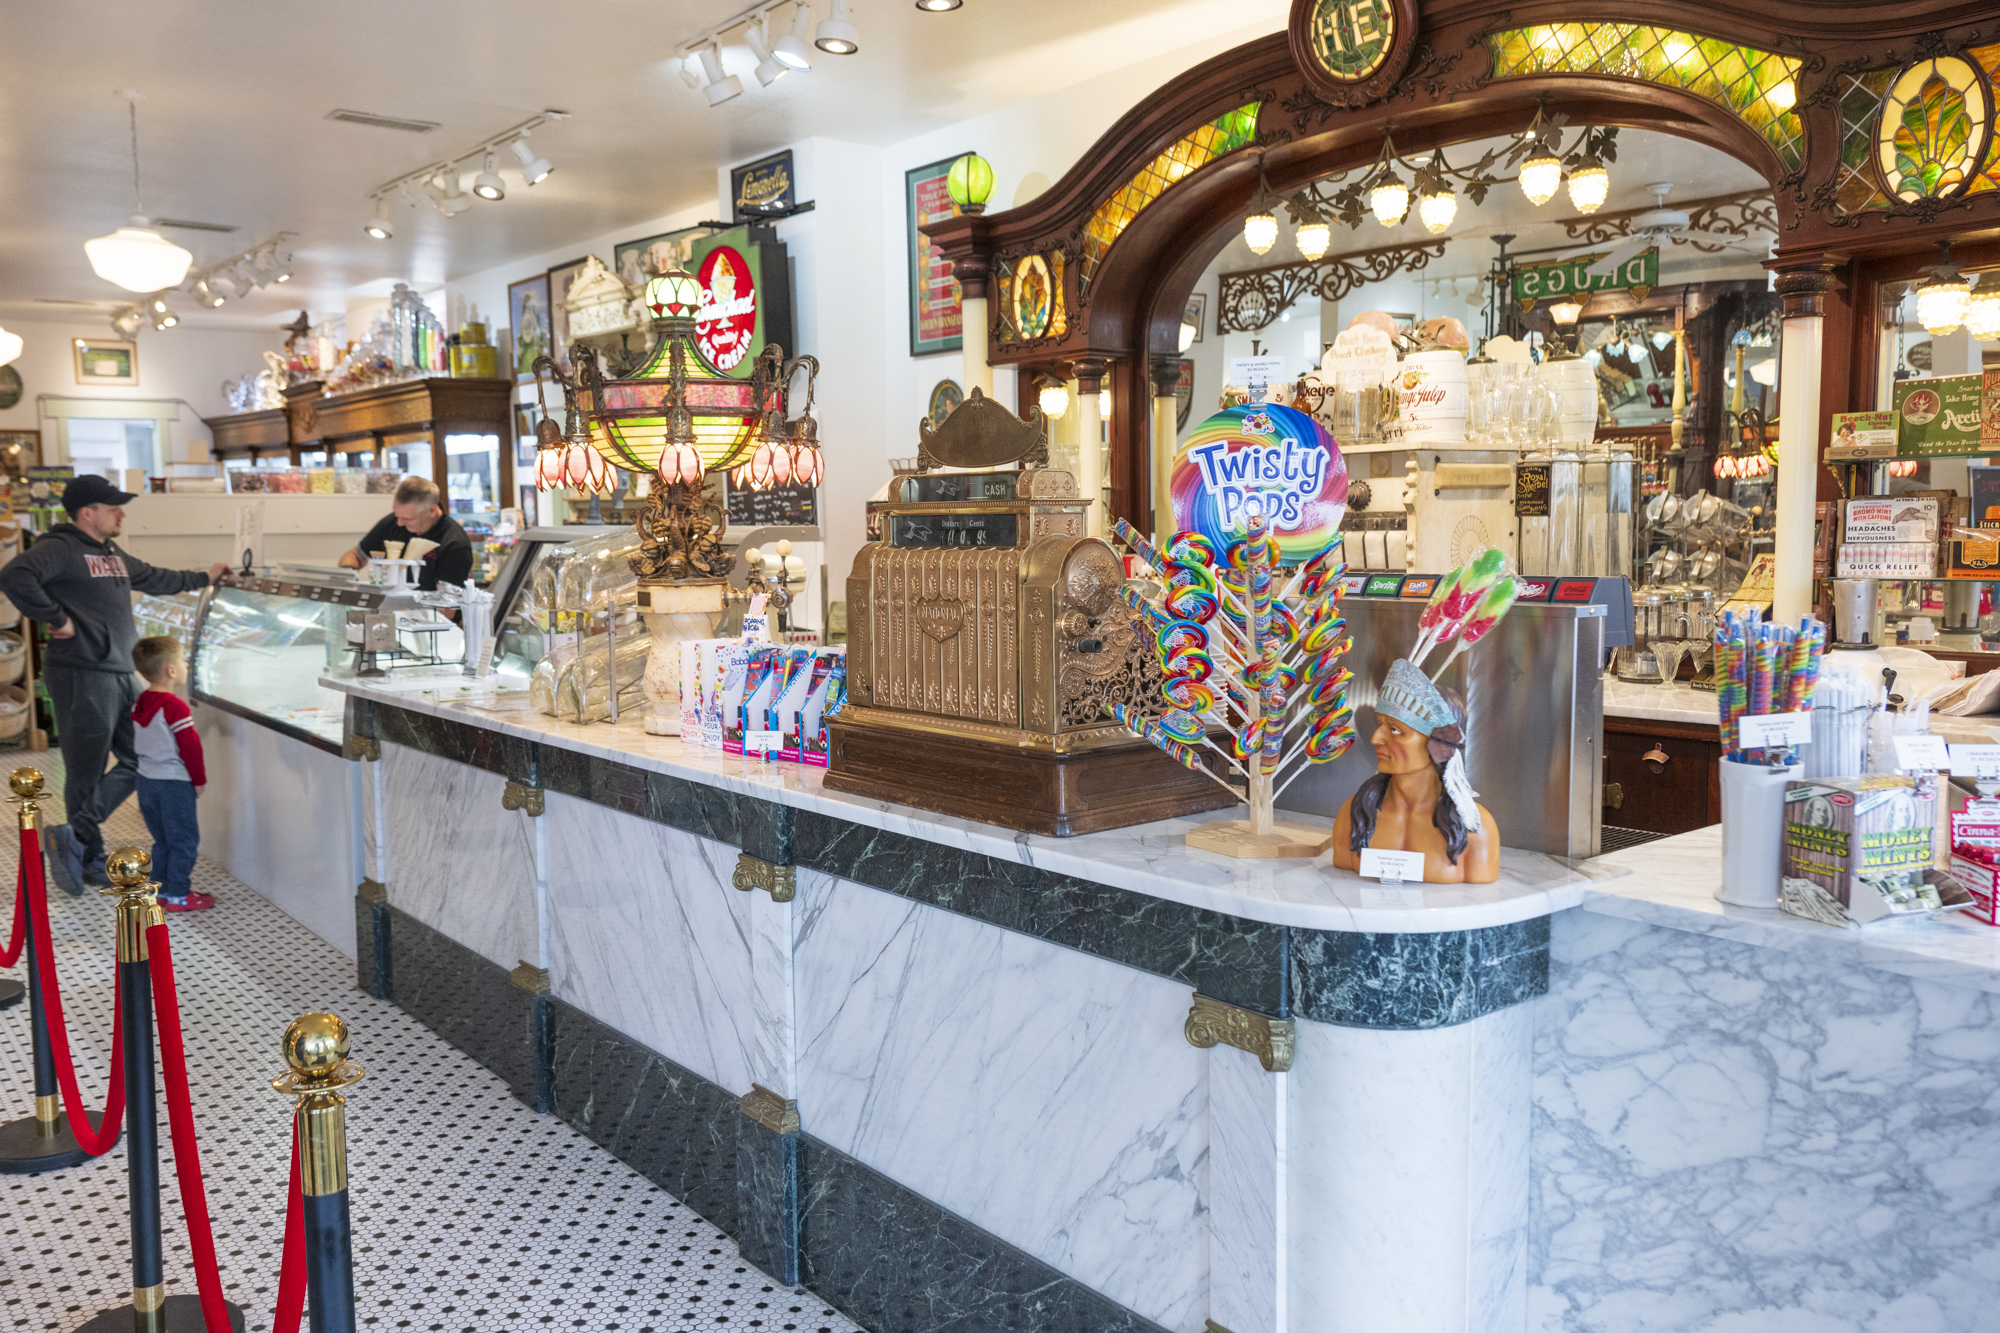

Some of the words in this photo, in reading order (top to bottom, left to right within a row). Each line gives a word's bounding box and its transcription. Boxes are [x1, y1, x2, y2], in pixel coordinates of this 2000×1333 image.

[717, 328, 753, 370] CREAM
[1945, 395, 1961, 403] Take
[1961, 394, 1979, 402] Home
[1840, 413, 1893, 422] Beech-Nut
[1941, 409, 1981, 430] Arcti
[1193, 441, 1325, 494] Twisty
[1520, 470, 1546, 483] Royal
[985, 485, 1006, 495] CASH
[1219, 485, 1300, 532] Pops
[1853, 508, 1892, 516] BROMO-MINT
[1370, 580, 1397, 590] Sprite
[1408, 581, 1428, 589] FANTA
[922, 606, 960, 620] NATIONAL
[745, 618, 764, 626] POPPING
[747, 624, 760, 632] BOBA
[731, 657, 749, 666] Boba
[1787, 820, 1851, 844] MONEY
[1862, 826, 1934, 849] MONEY
[1788, 834, 1849, 857] MINTS
[1864, 844, 1931, 867] MINTS
